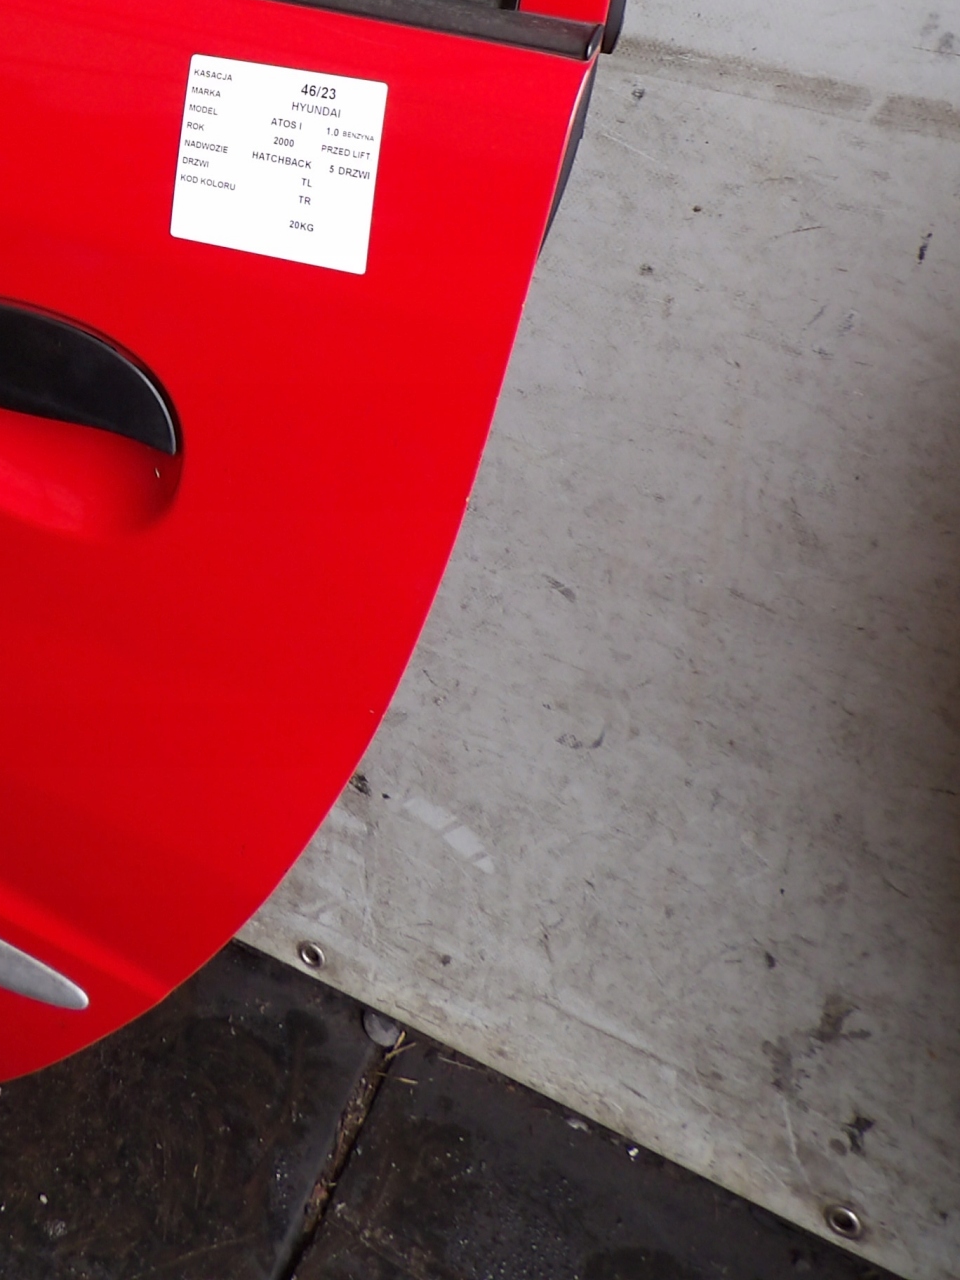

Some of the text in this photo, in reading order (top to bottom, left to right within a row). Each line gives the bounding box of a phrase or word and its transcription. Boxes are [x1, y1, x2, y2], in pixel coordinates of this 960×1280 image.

[194, 68, 233, 82] KASACJA
[191, 86, 221, 98] MARKA
[300, 83, 337, 101] 46/23
[189, 103, 218, 116] MODEL
[291, 101, 341, 118] HYUNDAI
[187, 121, 205, 131] ROK
[271, 118, 297, 129] ATOS
[326, 127, 375, 142] 1.0 BENZYNA
[184, 139, 229, 154] NADWOZIE
[273, 136, 295, 148] 2000
[321, 144, 351, 157] PRZED
[182, 156, 210, 168] DRZWI
[252, 151, 312, 170] HATCHBACK
[329, 165, 371, 180] 5 DRZWI
[180, 174, 236, 191] KOD KOLORU
[301, 177, 313, 188] TL
[298, 195, 311, 205] TR
[289, 220, 314, 233] 20KG
